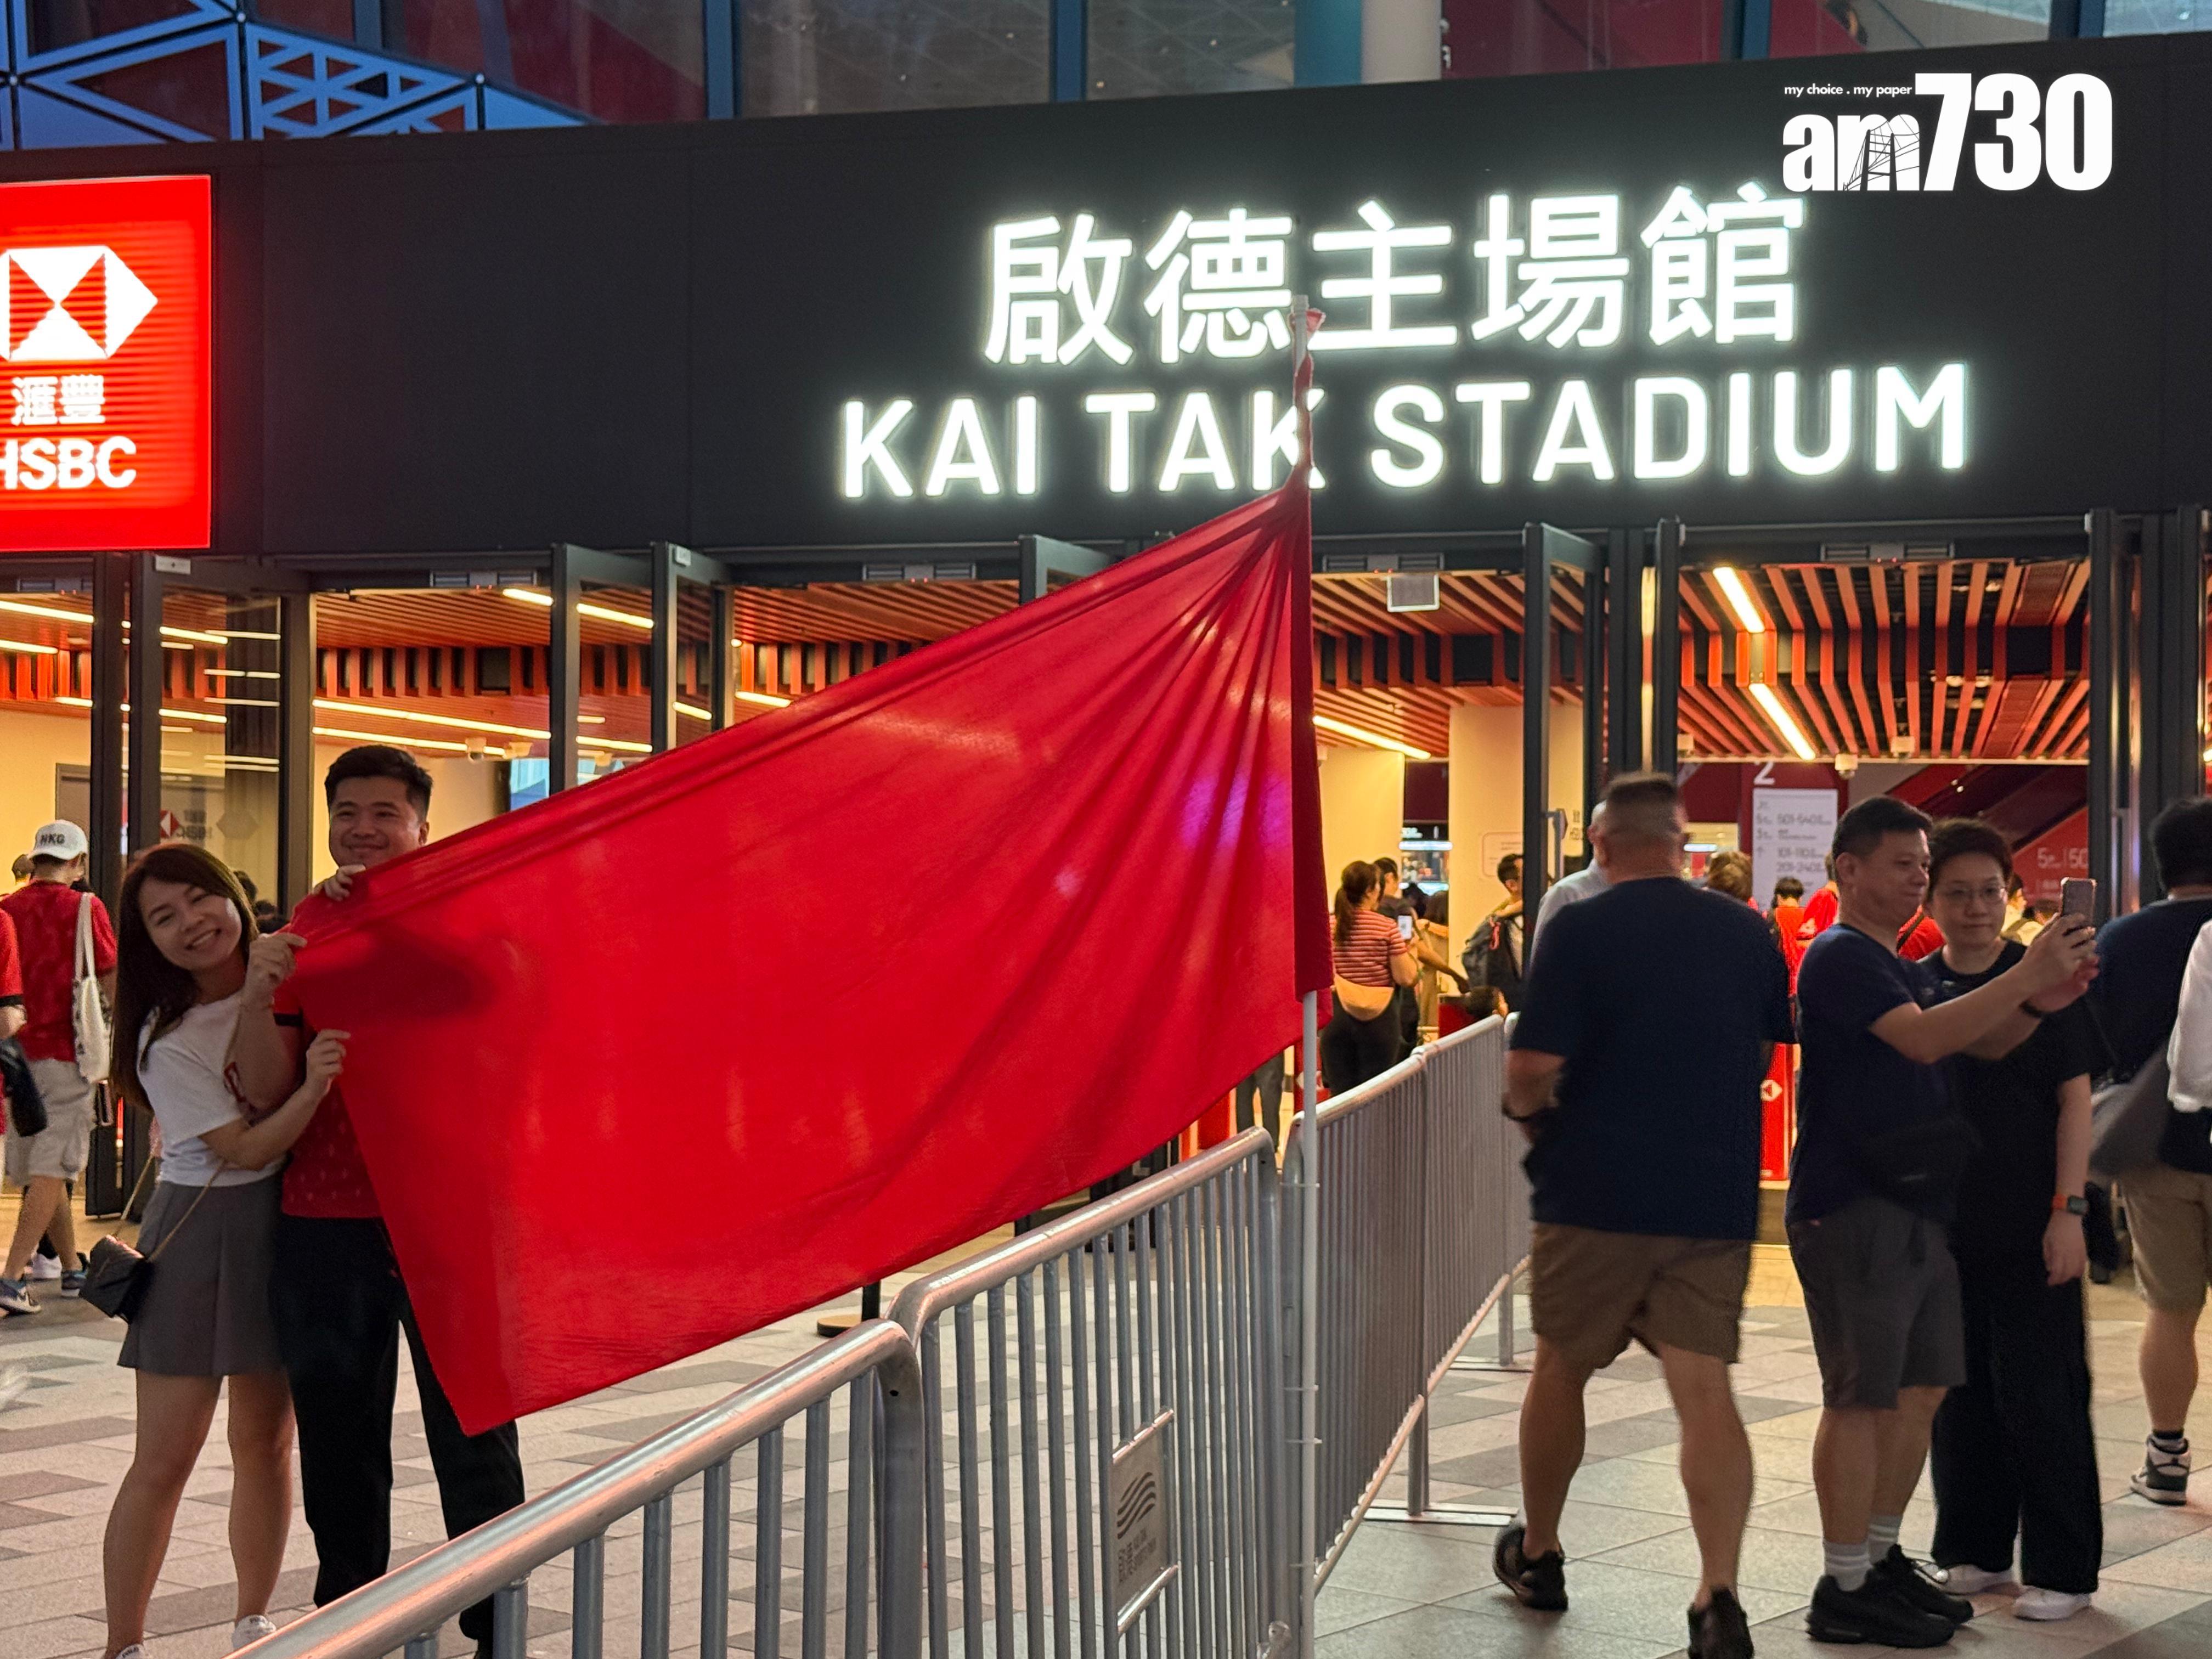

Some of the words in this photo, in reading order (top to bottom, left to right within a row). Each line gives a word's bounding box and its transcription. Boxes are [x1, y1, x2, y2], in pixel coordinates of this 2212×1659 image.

[985, 182, 1804, 365] 啟德主場館
[845, 396, 1037, 498] KAI
[1085, 388, 1325, 493] TAK
[1370, 363, 1965, 488] STADIUM
